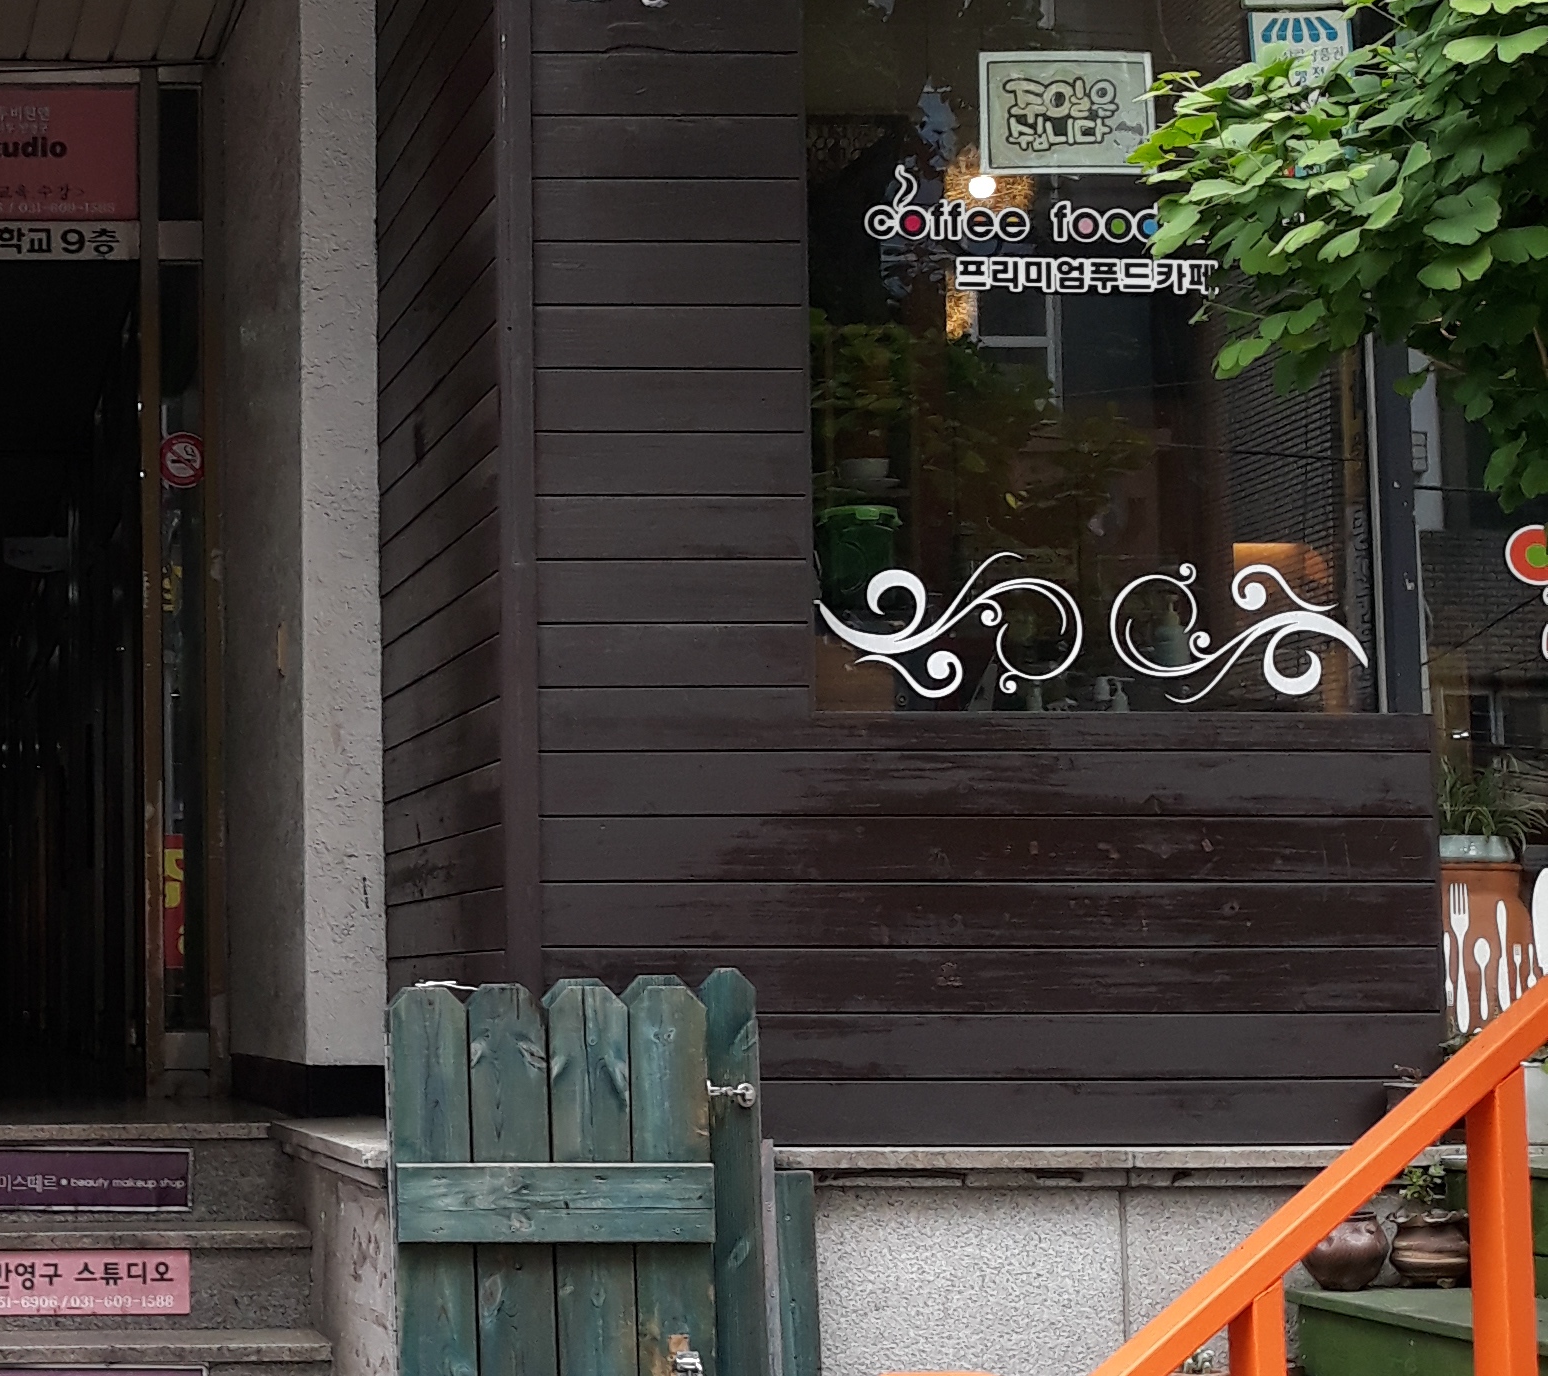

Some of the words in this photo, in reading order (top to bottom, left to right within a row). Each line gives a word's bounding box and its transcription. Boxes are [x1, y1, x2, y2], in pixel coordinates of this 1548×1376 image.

[1003, 77, 1119, 124] 주일은
[864, 202, 1030, 242] coffee
[74, 1261, 175, 1287] 스튜디오
